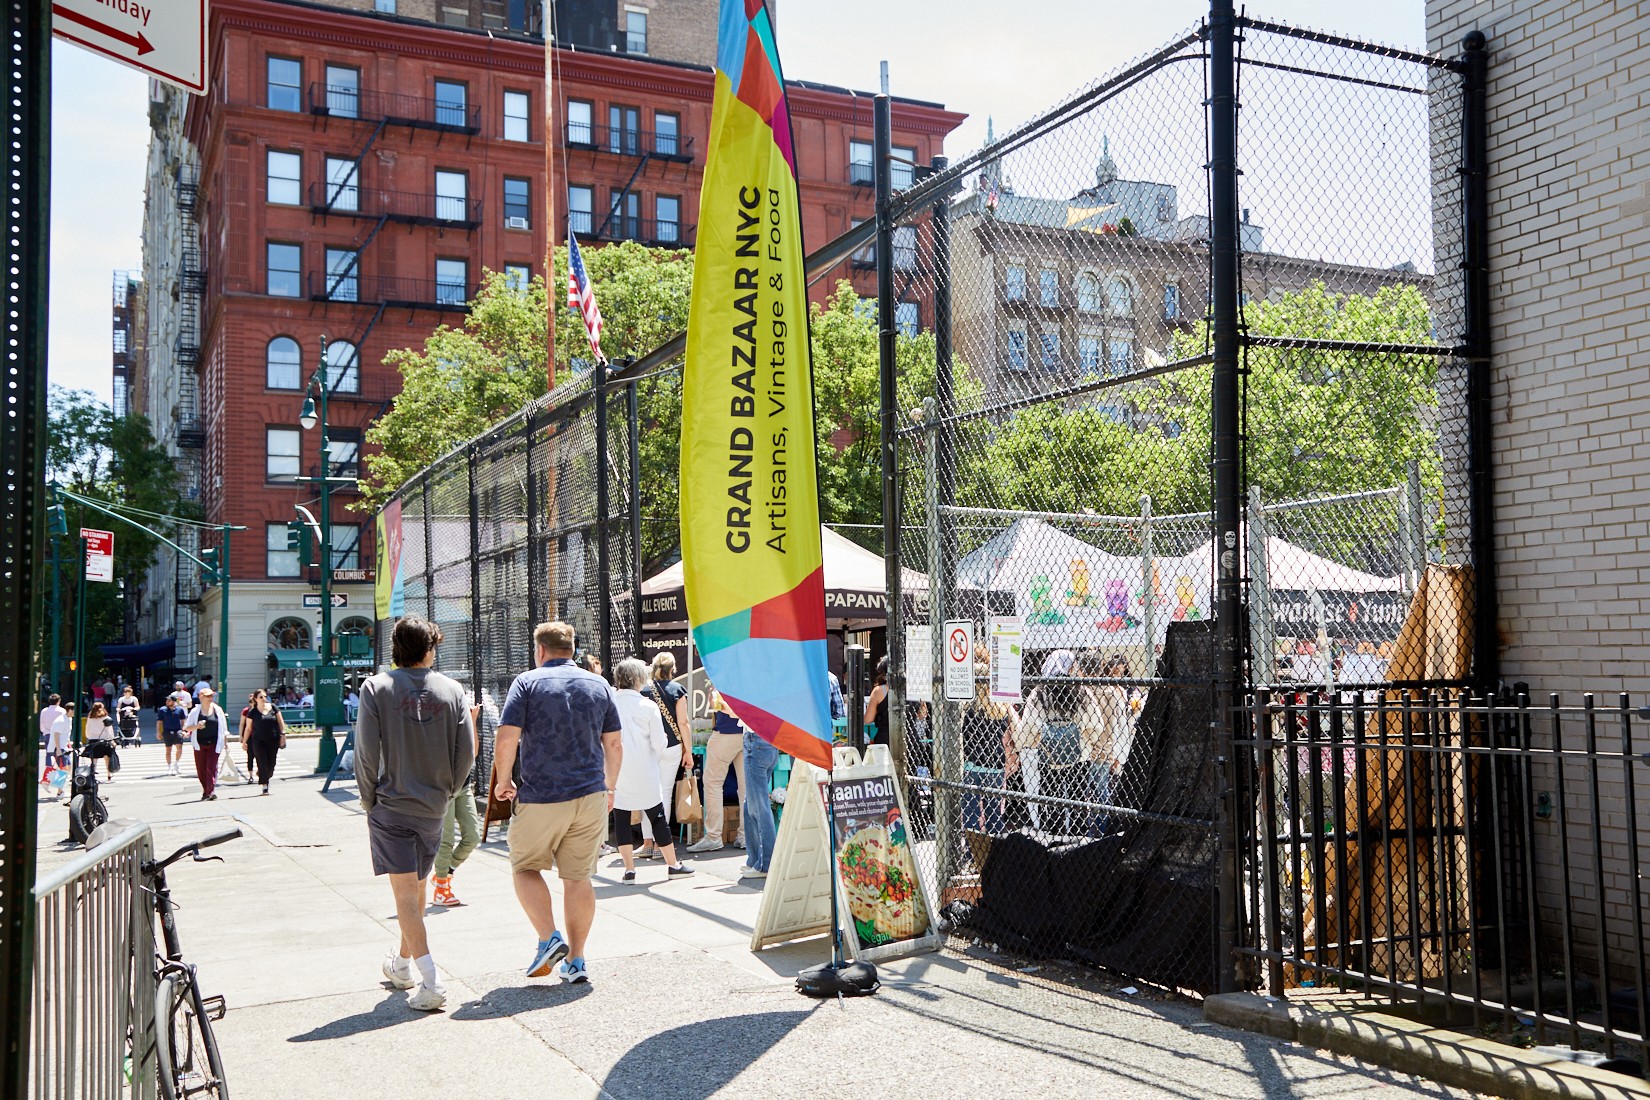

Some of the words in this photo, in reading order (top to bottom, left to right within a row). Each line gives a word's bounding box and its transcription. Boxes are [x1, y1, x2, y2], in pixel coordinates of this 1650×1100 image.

[735, 185, 761, 258] NYC
[768, 187, 783, 262] Food
[769, 272, 783, 289] &
[730, 266, 759, 418] BAZAAR
[768, 301, 788, 418] Vintage
[726, 427, 754, 554] GRAND
[766, 426, 788, 554] Artisans,
[334, 571, 366, 580] COLUMBUS
[641, 597, 653, 613] ALL
[654, 596, 677, 612] EVENTS
[1359, 598, 1409, 623] Yum
[864, 778, 894, 798] Roll
